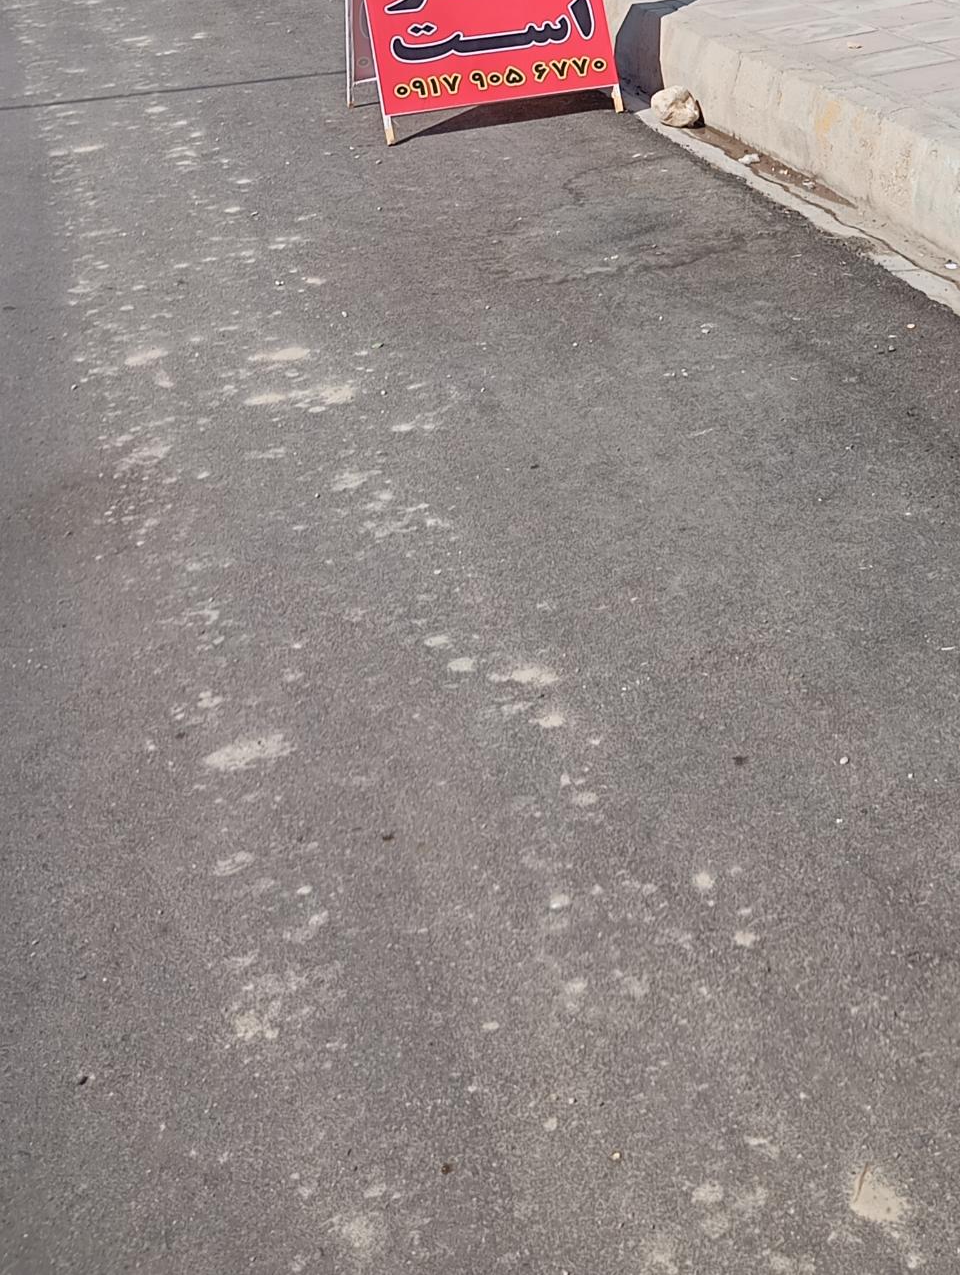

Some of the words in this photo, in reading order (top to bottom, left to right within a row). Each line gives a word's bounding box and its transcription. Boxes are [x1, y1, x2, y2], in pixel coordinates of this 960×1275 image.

[394, 72, 461, 99] ۰۹۱۷
[469, 67, 526, 92] ۹۰۵
[532, 56, 608, 82] ۶۷۷۰
